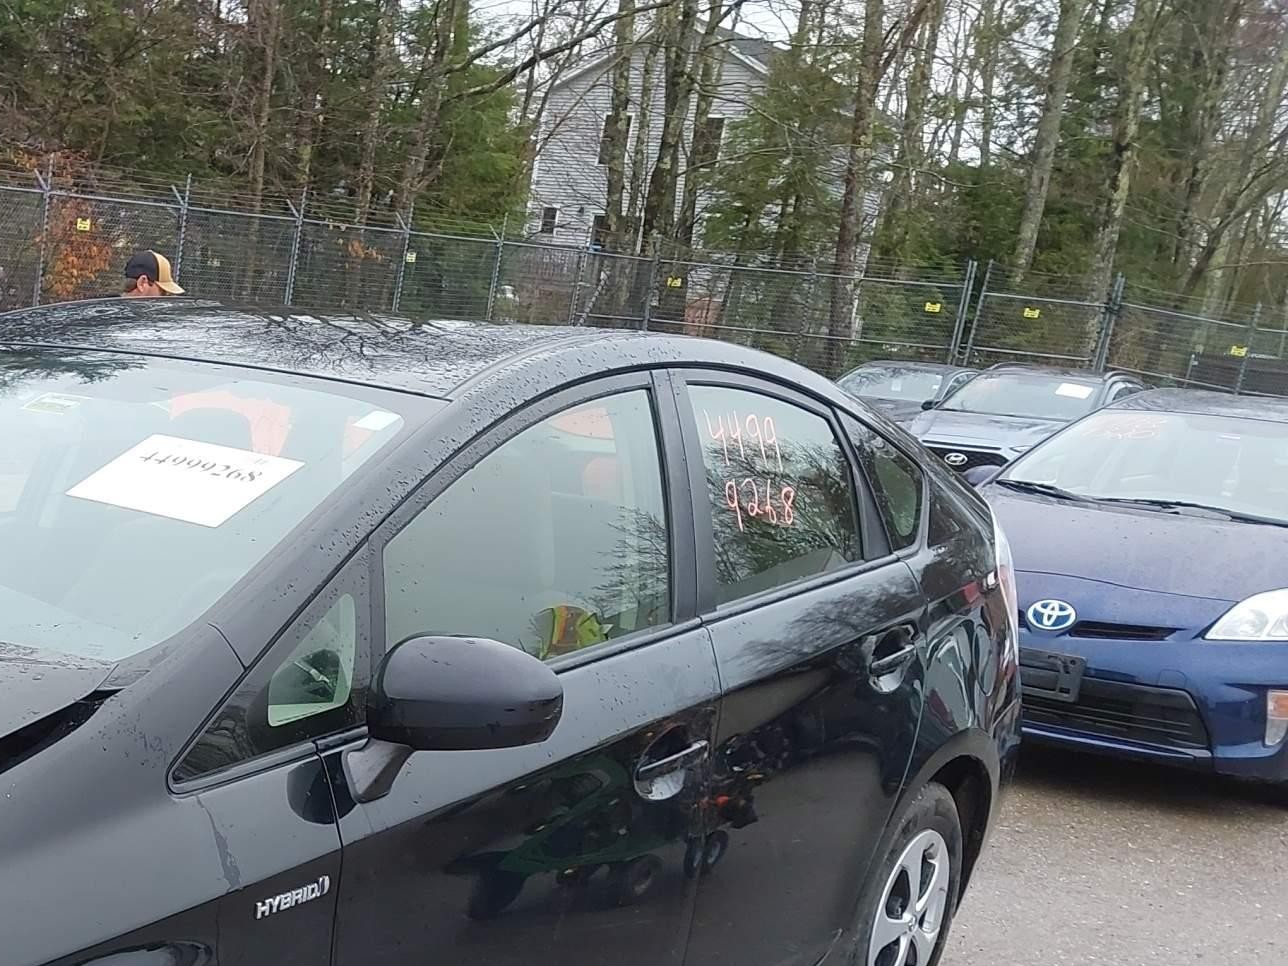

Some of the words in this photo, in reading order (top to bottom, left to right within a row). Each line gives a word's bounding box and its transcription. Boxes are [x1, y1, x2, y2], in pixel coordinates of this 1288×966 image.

[703, 408, 784, 473] 4499
[139, 451, 264, 483] 44999268
[724, 477, 795, 532] 9268
[255, 881, 320, 920] HYBRID
